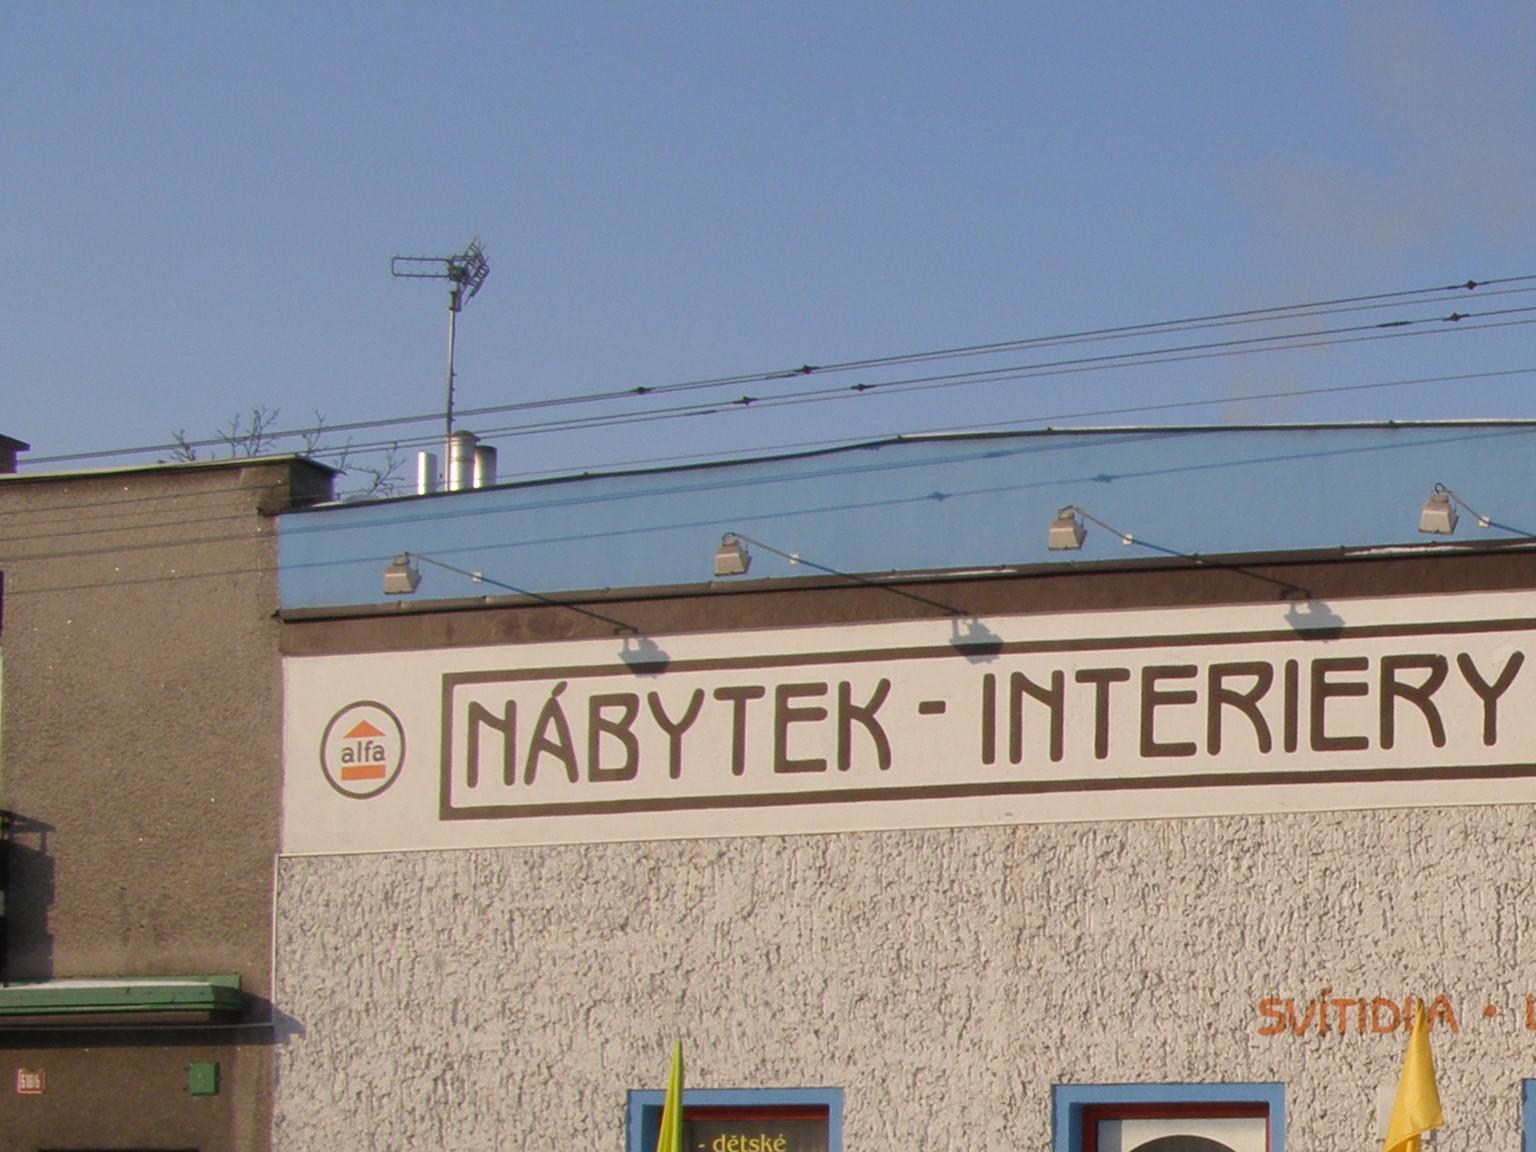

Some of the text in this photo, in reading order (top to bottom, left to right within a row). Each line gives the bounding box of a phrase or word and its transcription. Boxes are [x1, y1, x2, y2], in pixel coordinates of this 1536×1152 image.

[466, 678, 893, 789] NÁBYTEK
[981, 649, 1527, 766] INTERIERY
[341, 737, 387, 765] alfa
[712, 1133, 787, 1152] dětské
